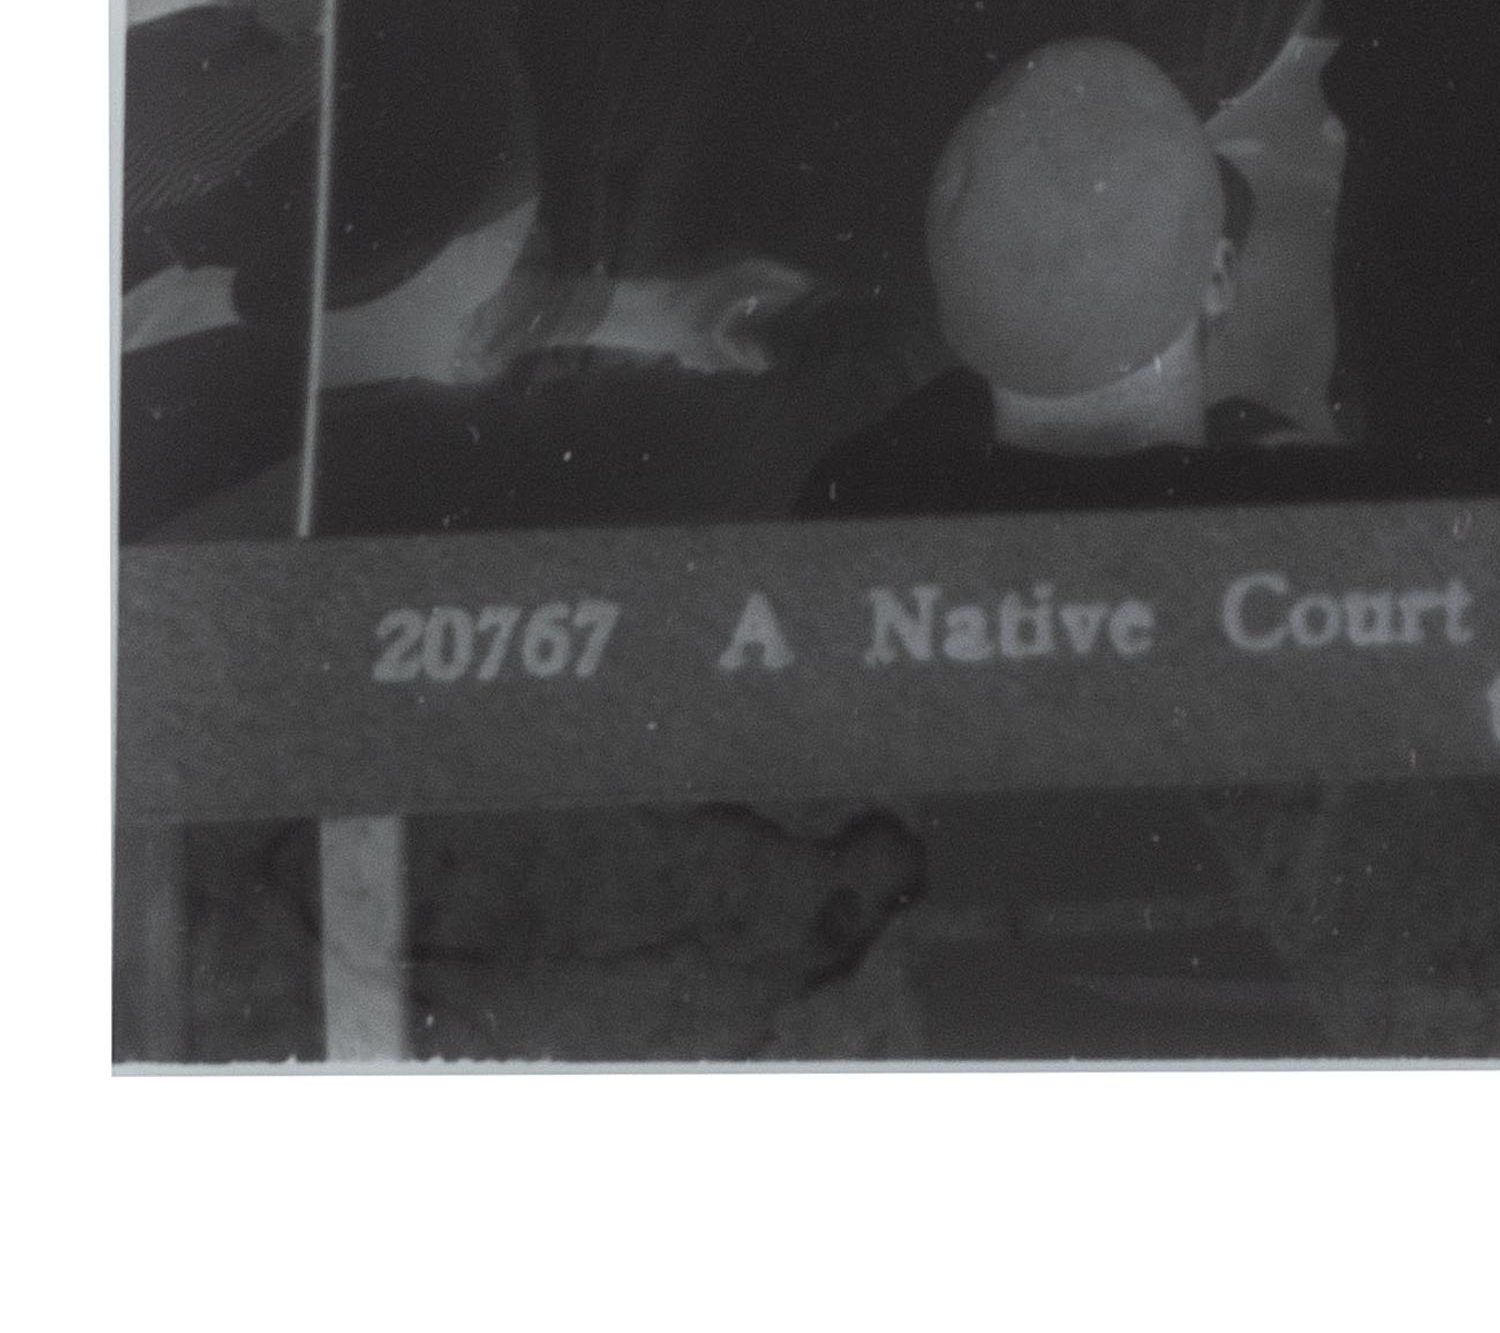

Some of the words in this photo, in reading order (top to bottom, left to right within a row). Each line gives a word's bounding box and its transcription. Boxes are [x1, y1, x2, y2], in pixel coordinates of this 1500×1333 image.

[371, 595, 623, 684] 20767
[716, 589, 799, 676] A
[860, 577, 1157, 668] Native
[1221, 569, 1472, 653] Court
